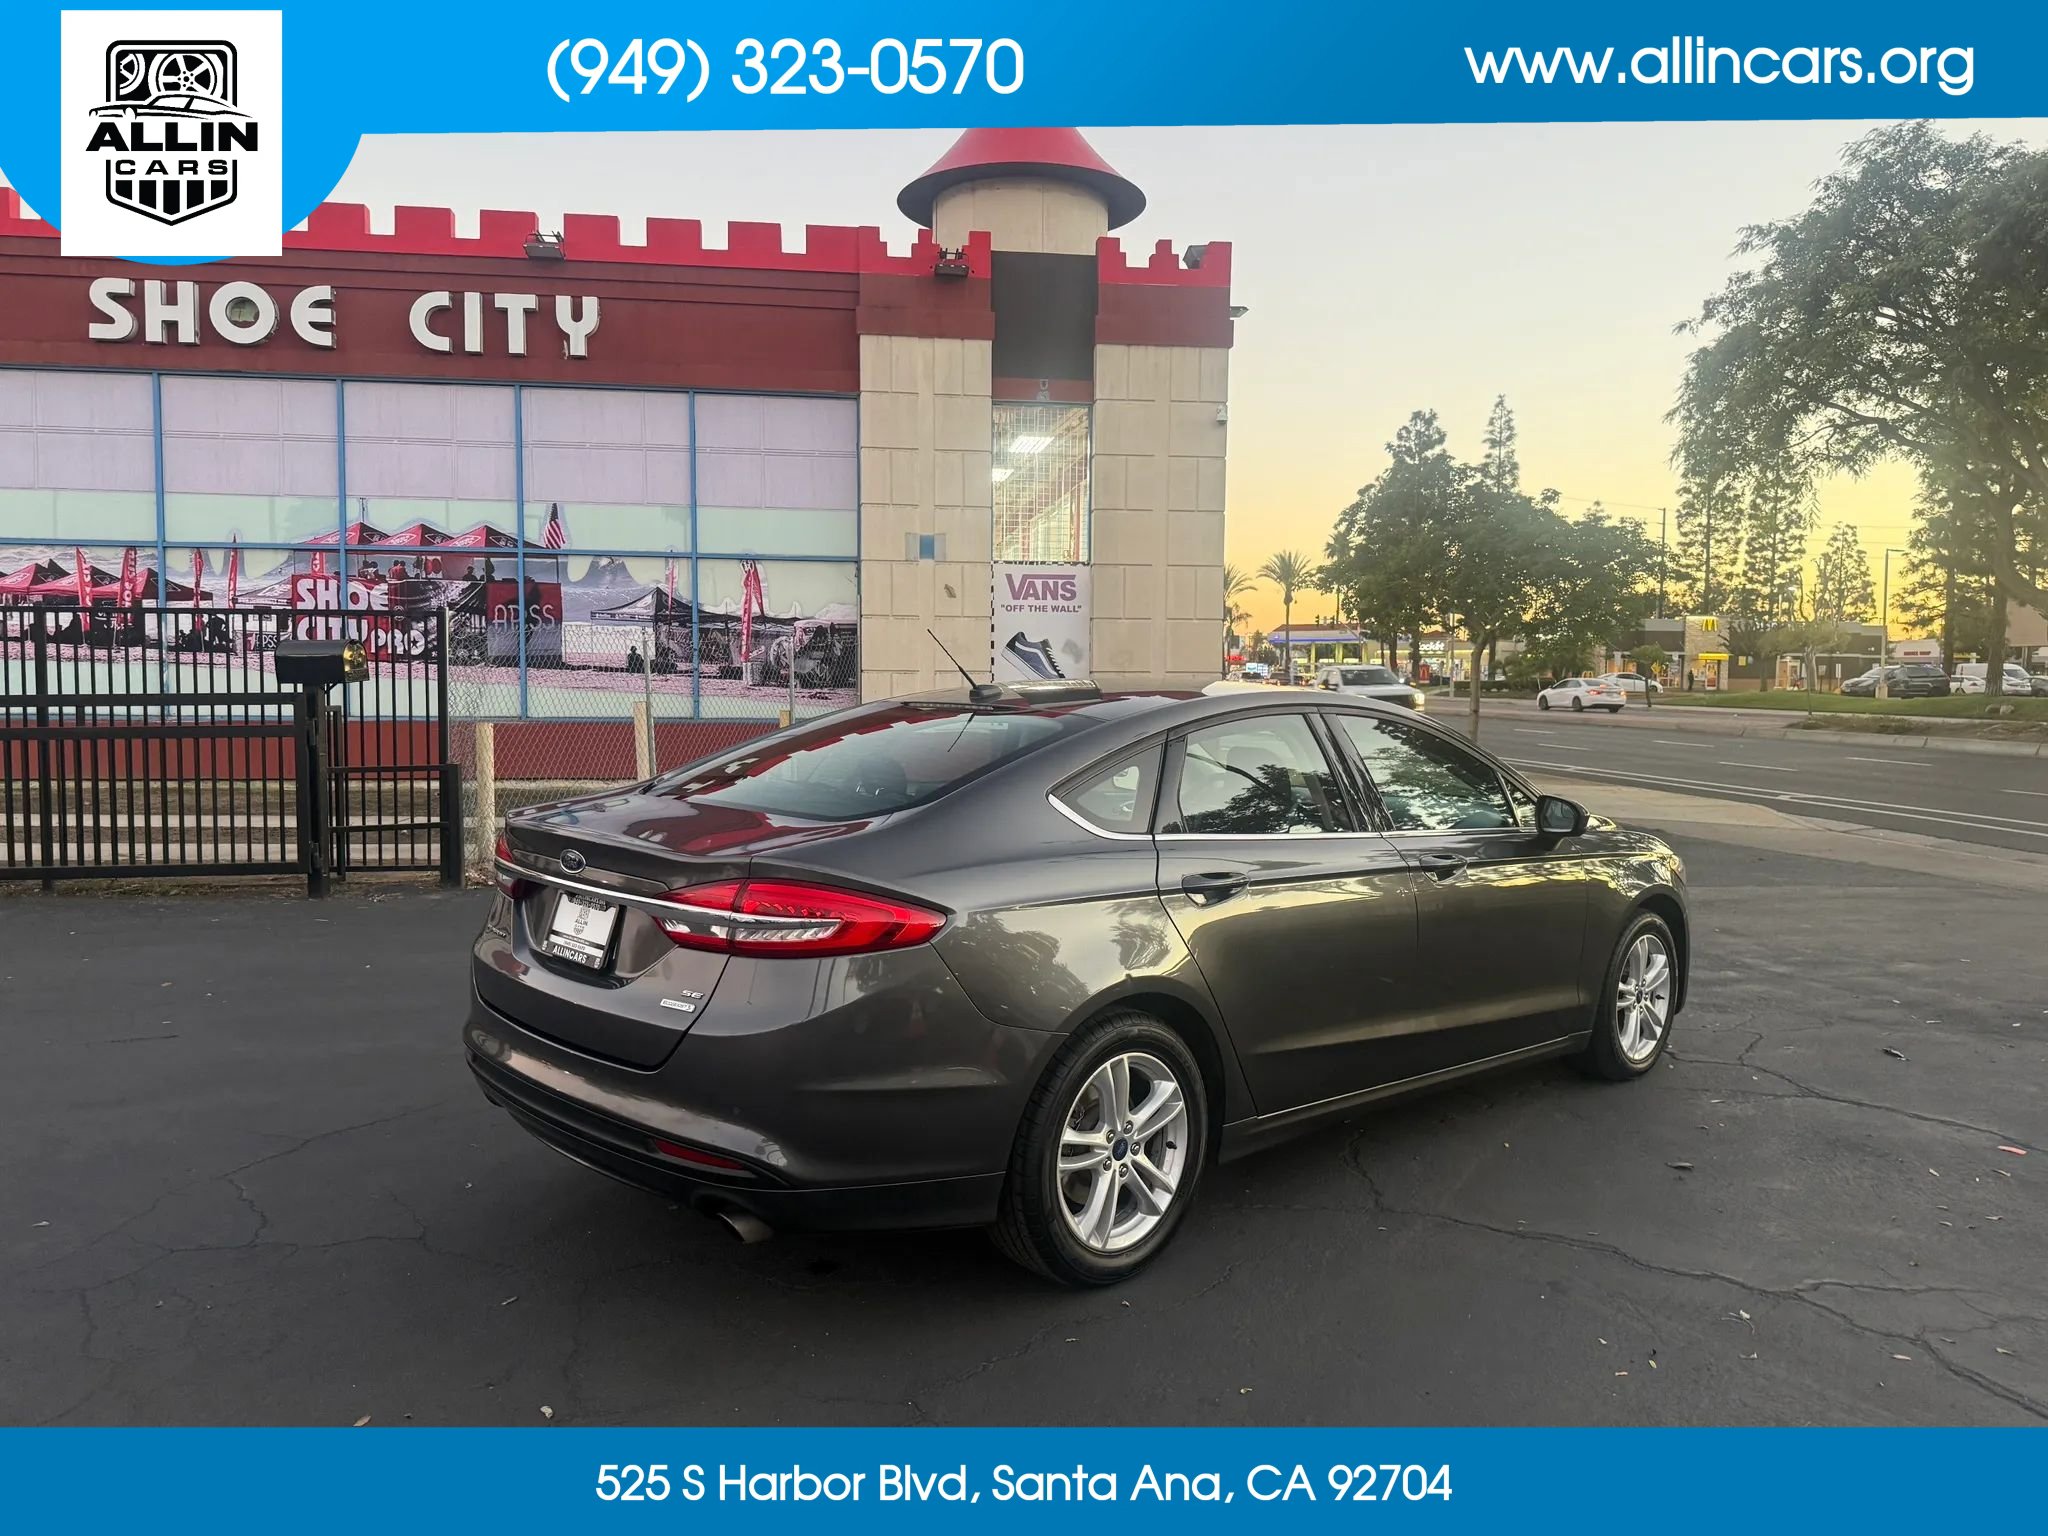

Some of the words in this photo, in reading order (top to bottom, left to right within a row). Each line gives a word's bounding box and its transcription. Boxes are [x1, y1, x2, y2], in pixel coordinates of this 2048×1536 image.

[88, 277, 337, 349] SHOE
[409, 291, 601, 357] CITY
[296, 578, 389, 611] SHOE
[1005, 573, 1077, 602] VANS
[1001, 604, 1025, 613] "OFF
[1028, 605, 1048, 613] THE
[1051, 605, 1082, 613] WALL"
[553, 945, 588, 964] ALLINCARS
[681, 989, 704, 999] SE
